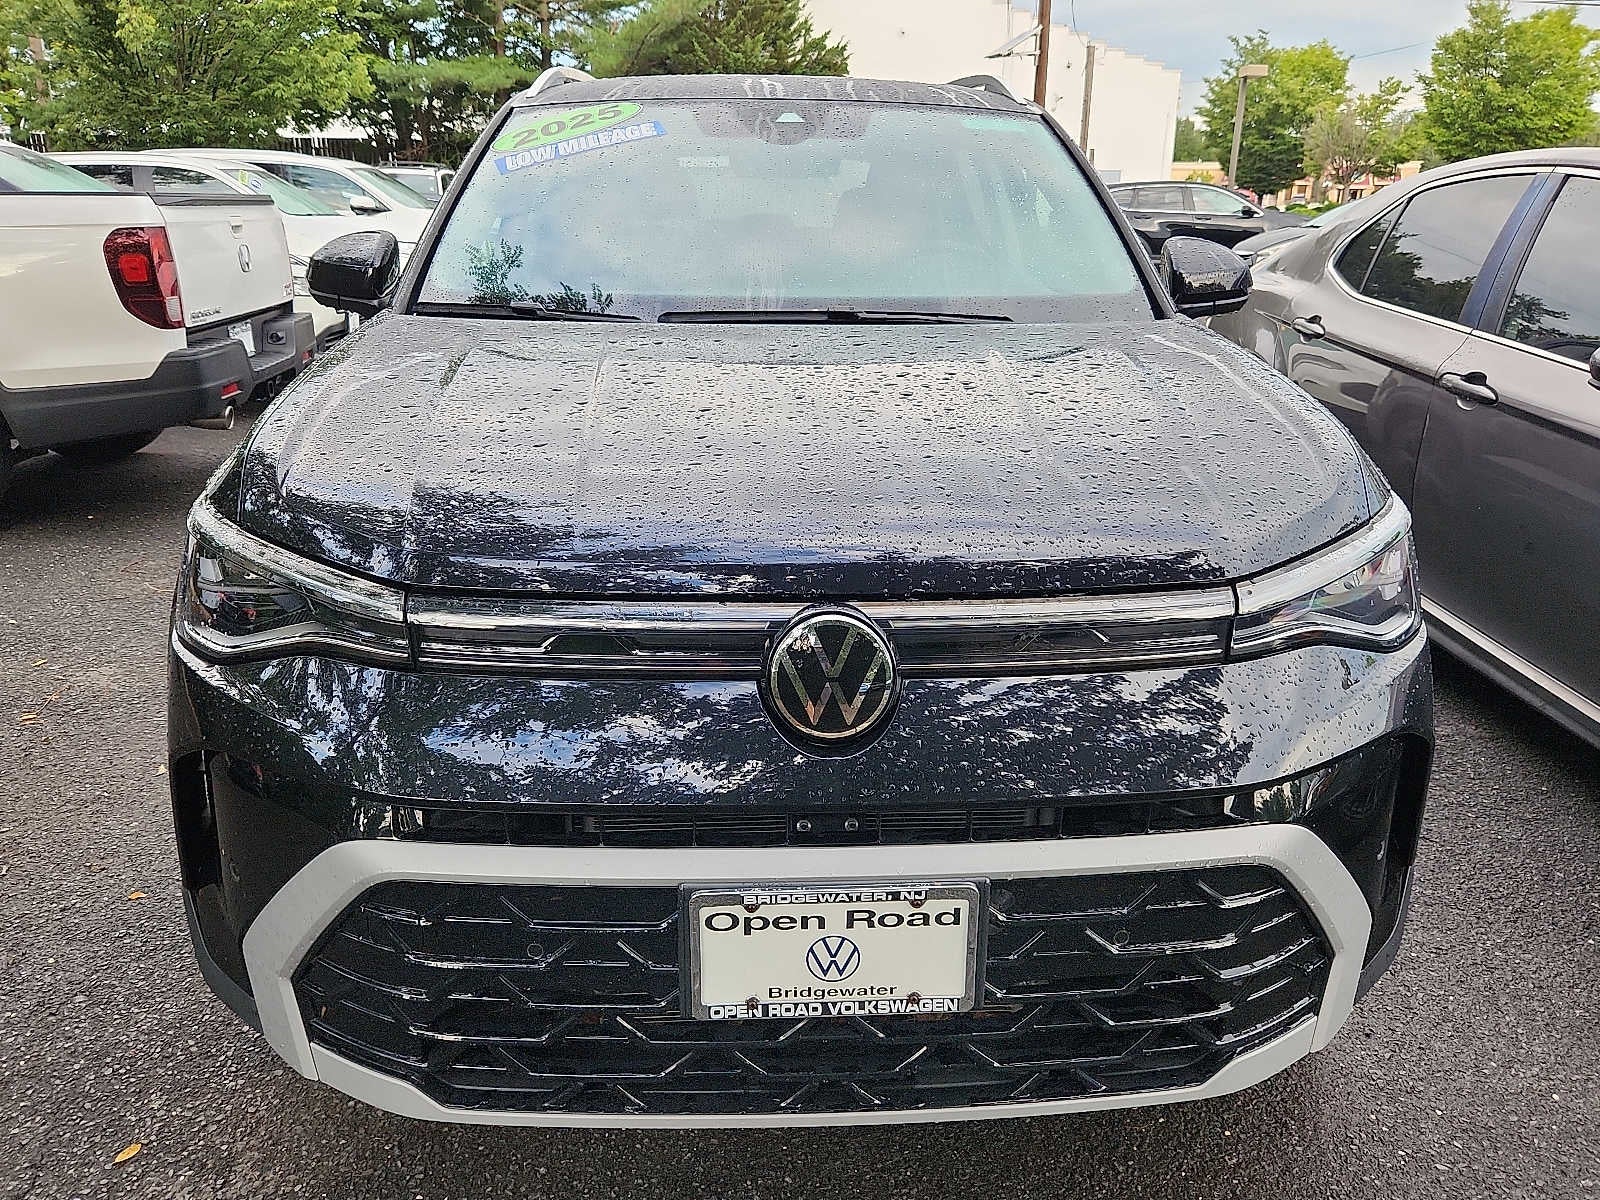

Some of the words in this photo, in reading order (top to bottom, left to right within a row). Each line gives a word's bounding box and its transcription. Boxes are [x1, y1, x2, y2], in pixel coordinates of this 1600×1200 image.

[512, 105, 622, 149] 2025
[505, 145, 558, 171] LOW
[558, 122, 657, 156] MILEAGE
[743, 892, 893, 905] BRIDGEWATER,
[900, 890, 926, 900] NJ
[704, 911, 826, 935] Open
[846, 907, 961, 929] Road
[808, 936, 858, 977] VW
[768, 985, 897, 1000] Bridgewater
[710, 1005, 762, 1019] OPEN
[768, 1003, 822, 1017] ROAD
[828, 998, 958, 1015] VOLKSWAGEN
